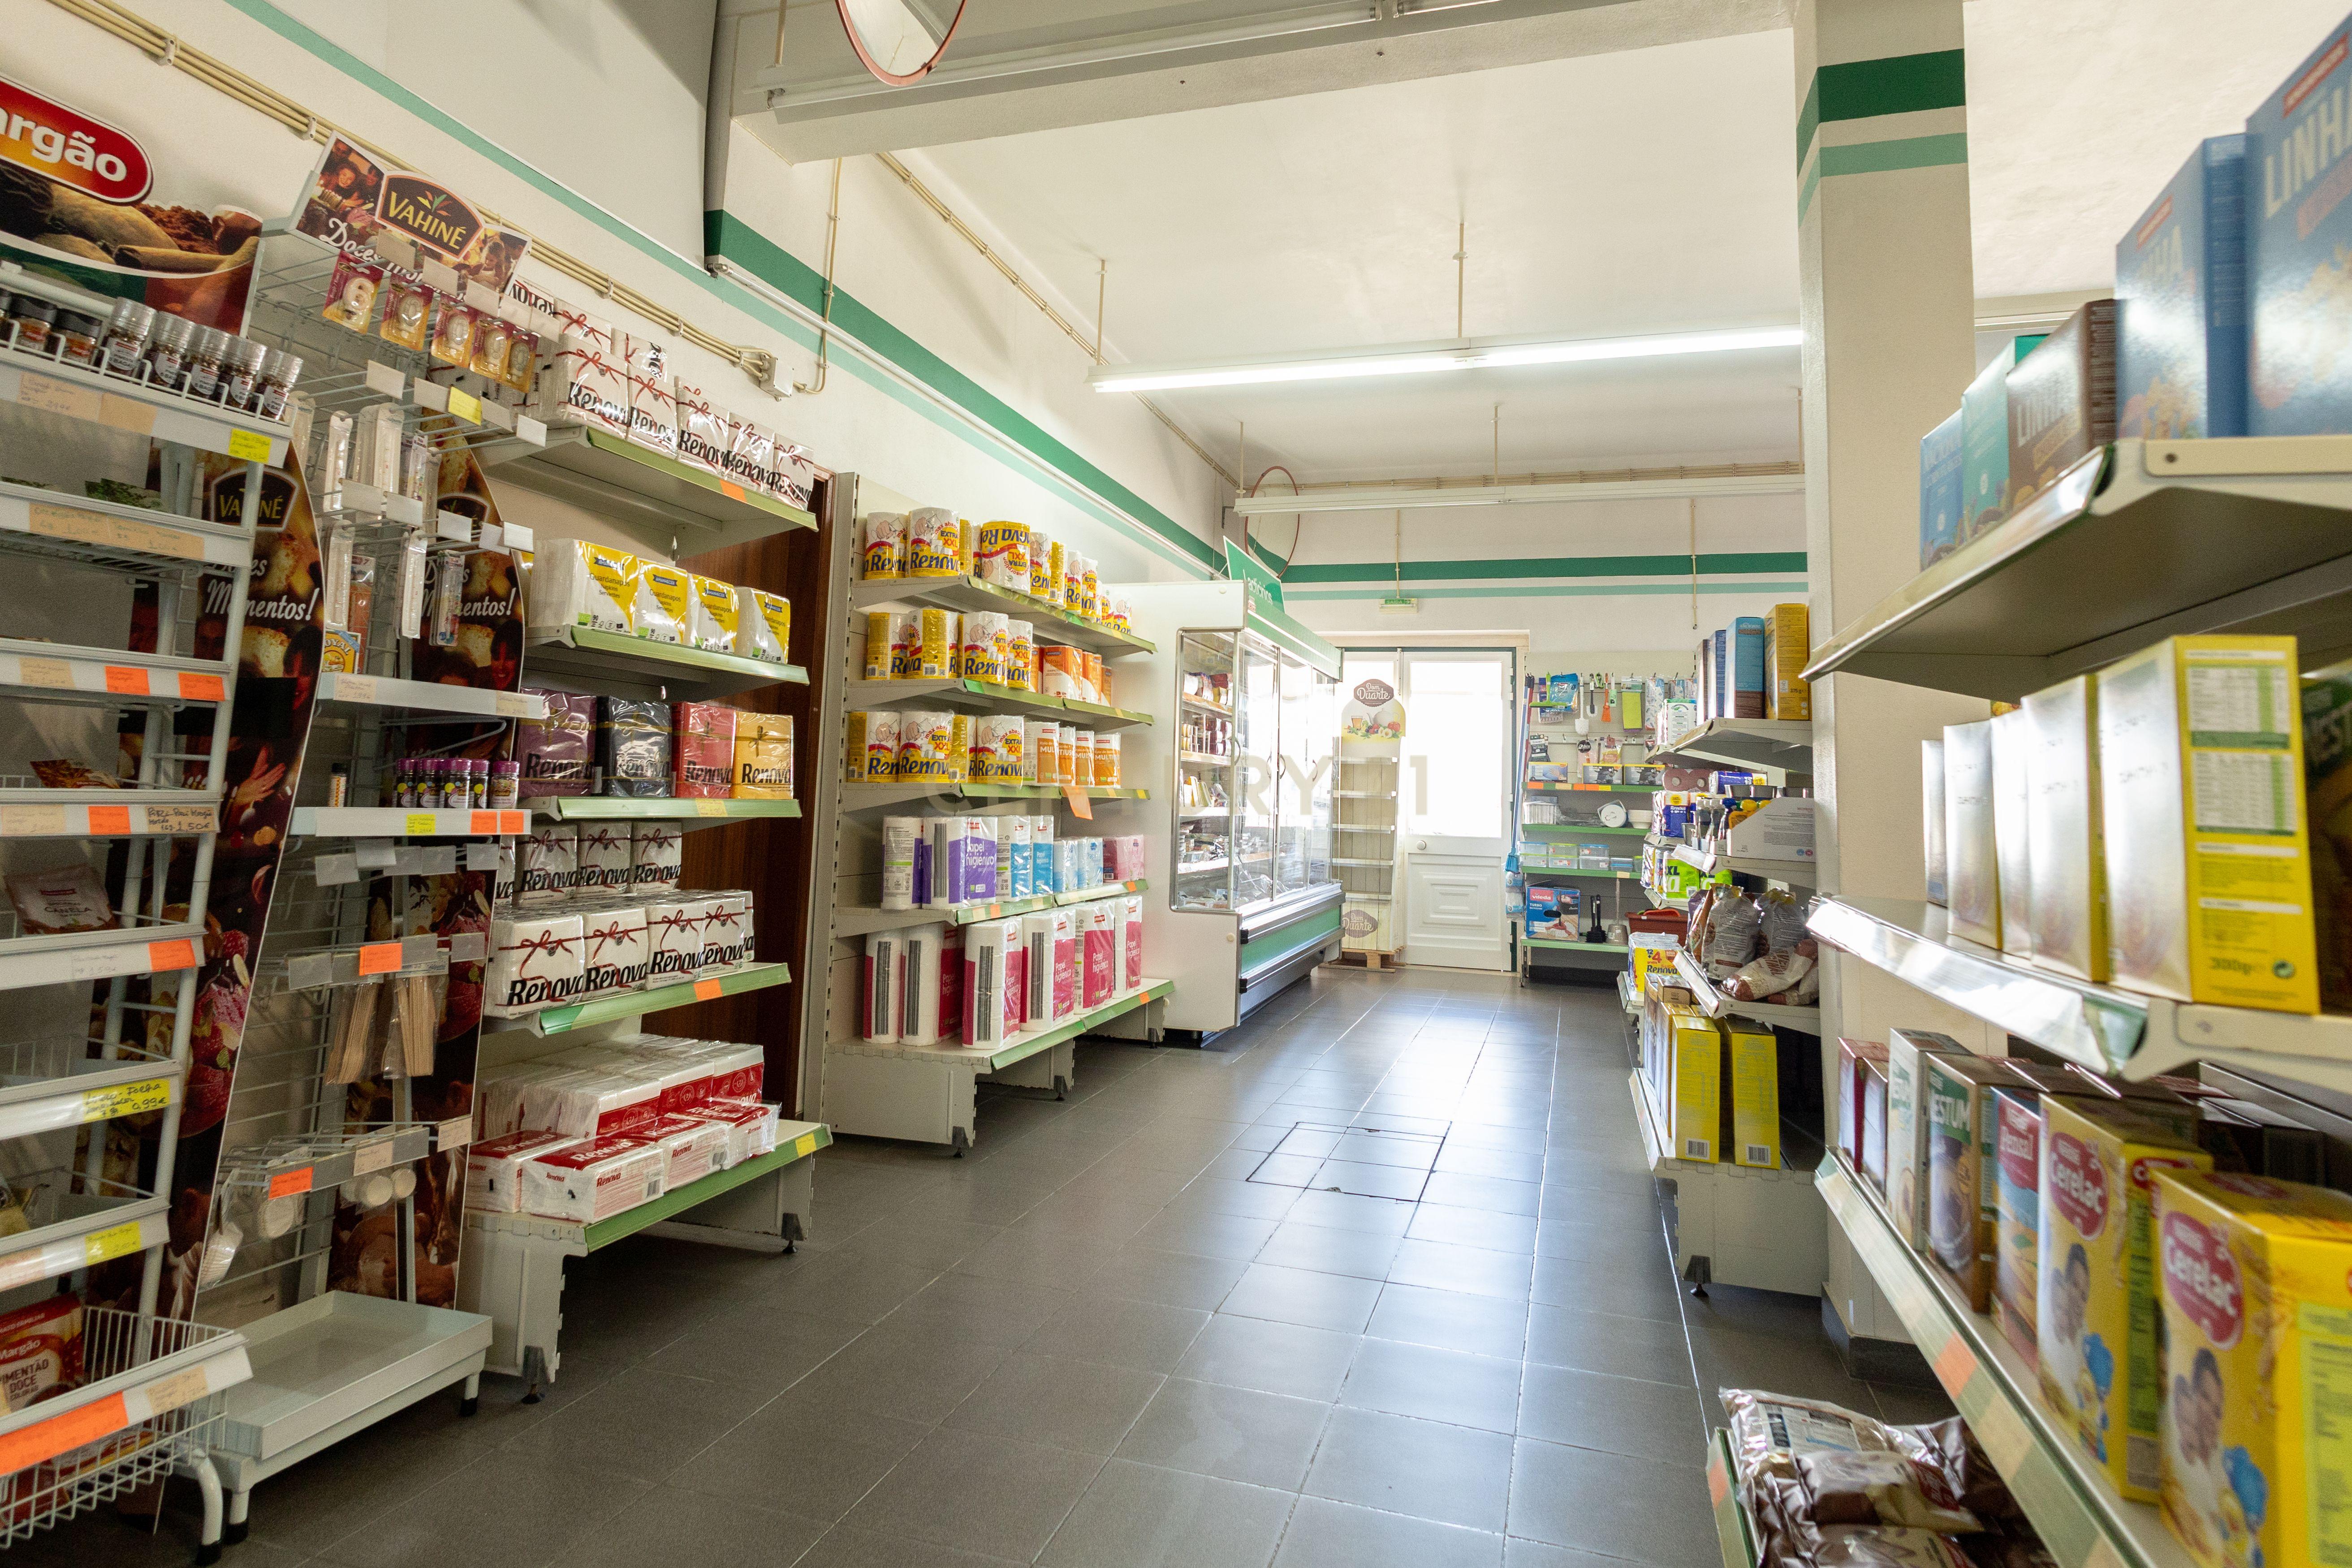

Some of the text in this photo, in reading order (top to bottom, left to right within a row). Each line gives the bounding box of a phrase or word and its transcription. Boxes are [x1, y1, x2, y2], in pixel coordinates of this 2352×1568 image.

[0, 107, 127, 181] rgão
[2265, 76, 2352, 219] LINH
[389, 191, 466, 250] VAHINÉ
[220, 495, 283, 519] VANÉ
[943, 538, 958, 548] XXL
[590, 573, 630, 587] Guardanapos
[205, 579, 319, 621] Mmentos!
[421, 587, 517, 617] Mentos!
[649, 588, 682, 603] Guardanapos
[700, 601, 732, 613] Guardanapos
[324, 638, 352, 656] OYAL
[997, 644, 1007, 652] XX
[1014, 651, 1030, 660] XXL
[964, 657, 1007, 676] Renov
[1356, 687, 1391, 700] Duarte
[1366, 682, 1381, 691] Dom
[742, 763, 791, 784] Renova
[900, 757, 949, 775] Renov
[522, 869, 577, 892] Renova
[634, 864, 681, 884] Renova
[1342, 917, 1373, 931] Duarte
[1351, 912, 1364, 921] Dom
[1127, 940, 1137, 950] Papel
[1093, 950, 1104, 962] Papel
[1652, 951, 1662, 963] 4
[1055, 960, 1066, 972] Papel
[1647, 965, 1677, 974] Renova
[585, 962, 647, 993] Renova
[508, 975, 583, 1007] Renova
[132, 1097, 167, 1110] 0,99€
[1931, 1089, 1970, 1132] ESTUM
[570, 1141, 634, 1162] Renova
[672, 1144, 693, 1158] Renova
[596, 1171, 622, 1188] Renova
[2050, 1151, 2102, 1214] Cerelac
[2166, 1235, 2237, 1316] Cerelac
[9, 1374, 38, 1393] DOCE
